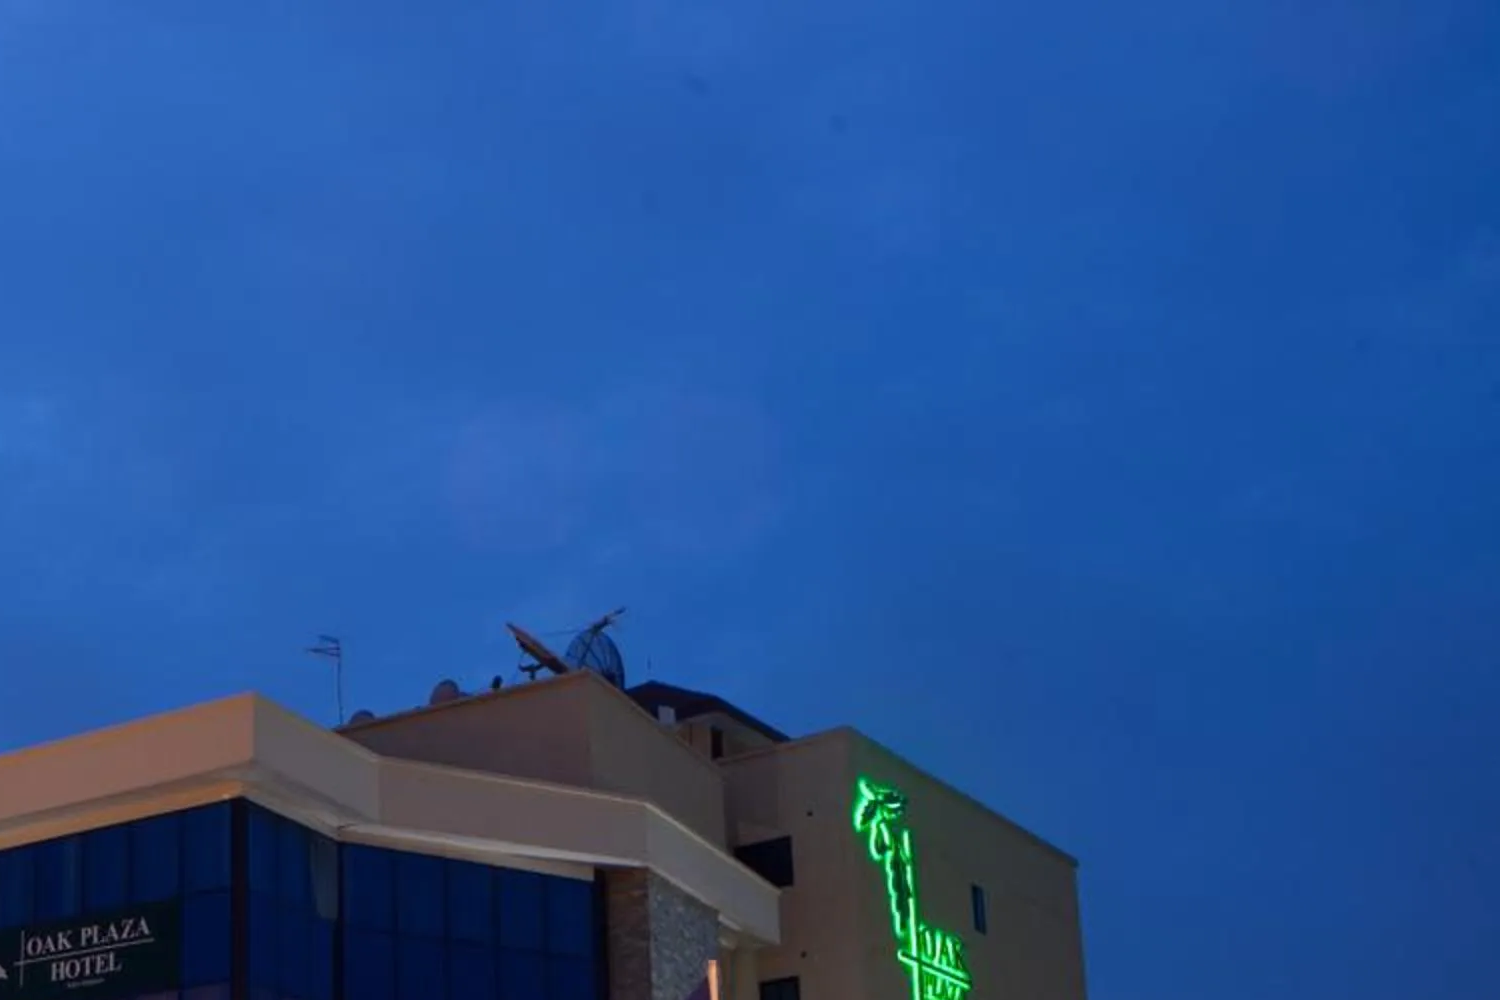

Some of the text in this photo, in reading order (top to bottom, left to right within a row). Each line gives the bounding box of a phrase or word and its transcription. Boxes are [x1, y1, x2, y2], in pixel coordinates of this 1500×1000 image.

[26, 916, 151, 957] OAK PLAZA
[51, 952, 122, 982] HOTEL
